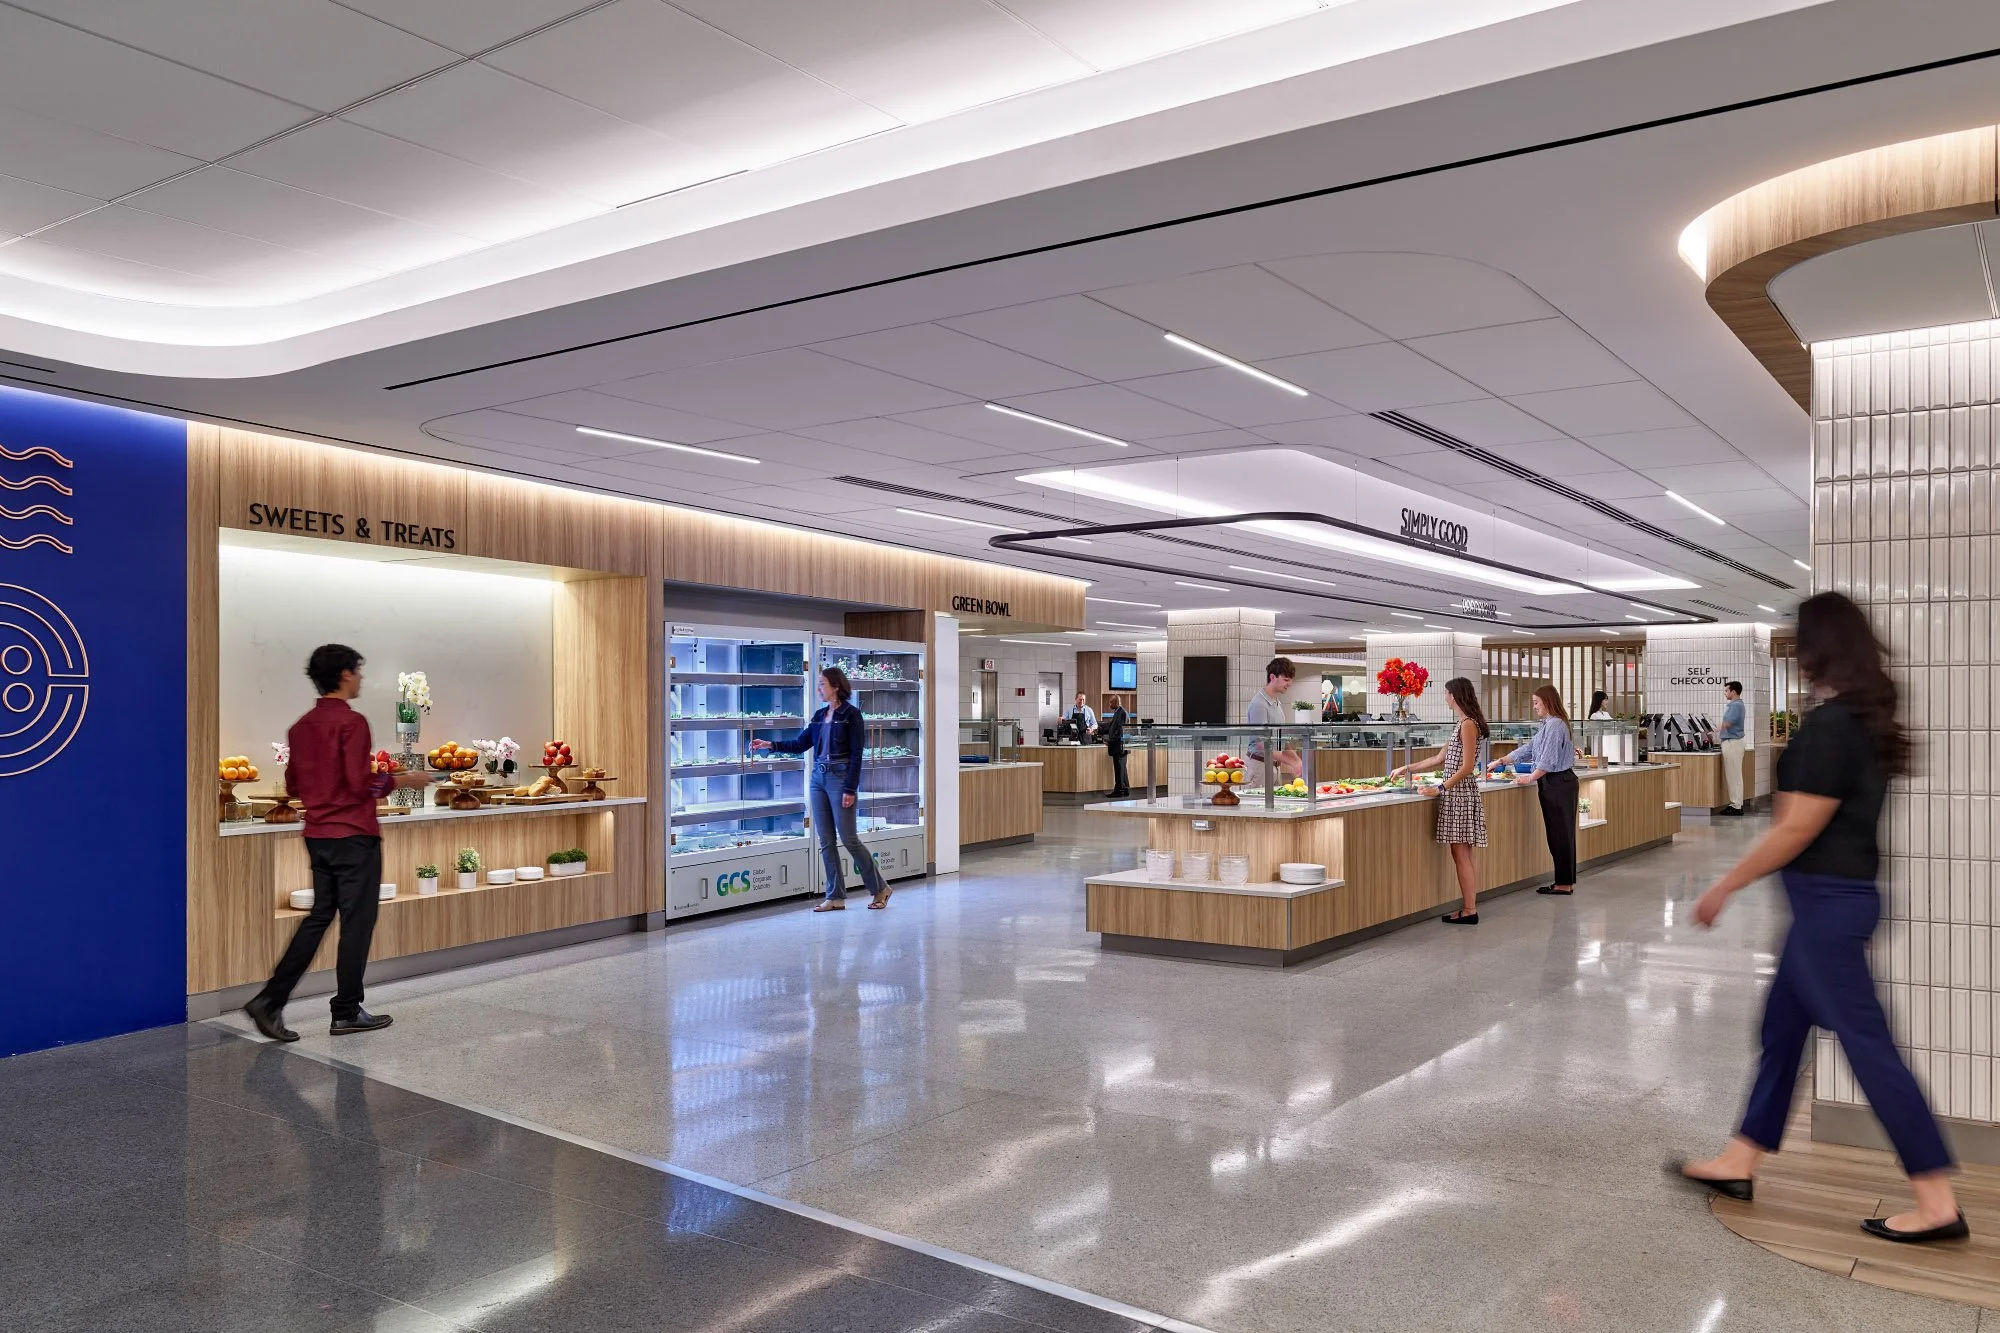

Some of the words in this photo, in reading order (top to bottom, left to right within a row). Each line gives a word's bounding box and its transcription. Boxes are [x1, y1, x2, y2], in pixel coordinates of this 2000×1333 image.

[249, 503, 344, 535] SWEETS
[355, 518, 371, 539] &
[381, 520, 455, 549] TREATS
[1401, 508, 1438, 538] SIMPLY
[1439, 520, 1468, 547] GOOD
[952, 596, 983, 614] GREEN
[985, 600, 1012, 617] BOWL
[1152, 675, 1168, 683] CHE
[1670, 677, 1705, 685] CHECK
[1706, 677, 1729, 685] OUT
[1687, 667, 1711, 676] SELF
[716, 870, 751, 897] GCS
